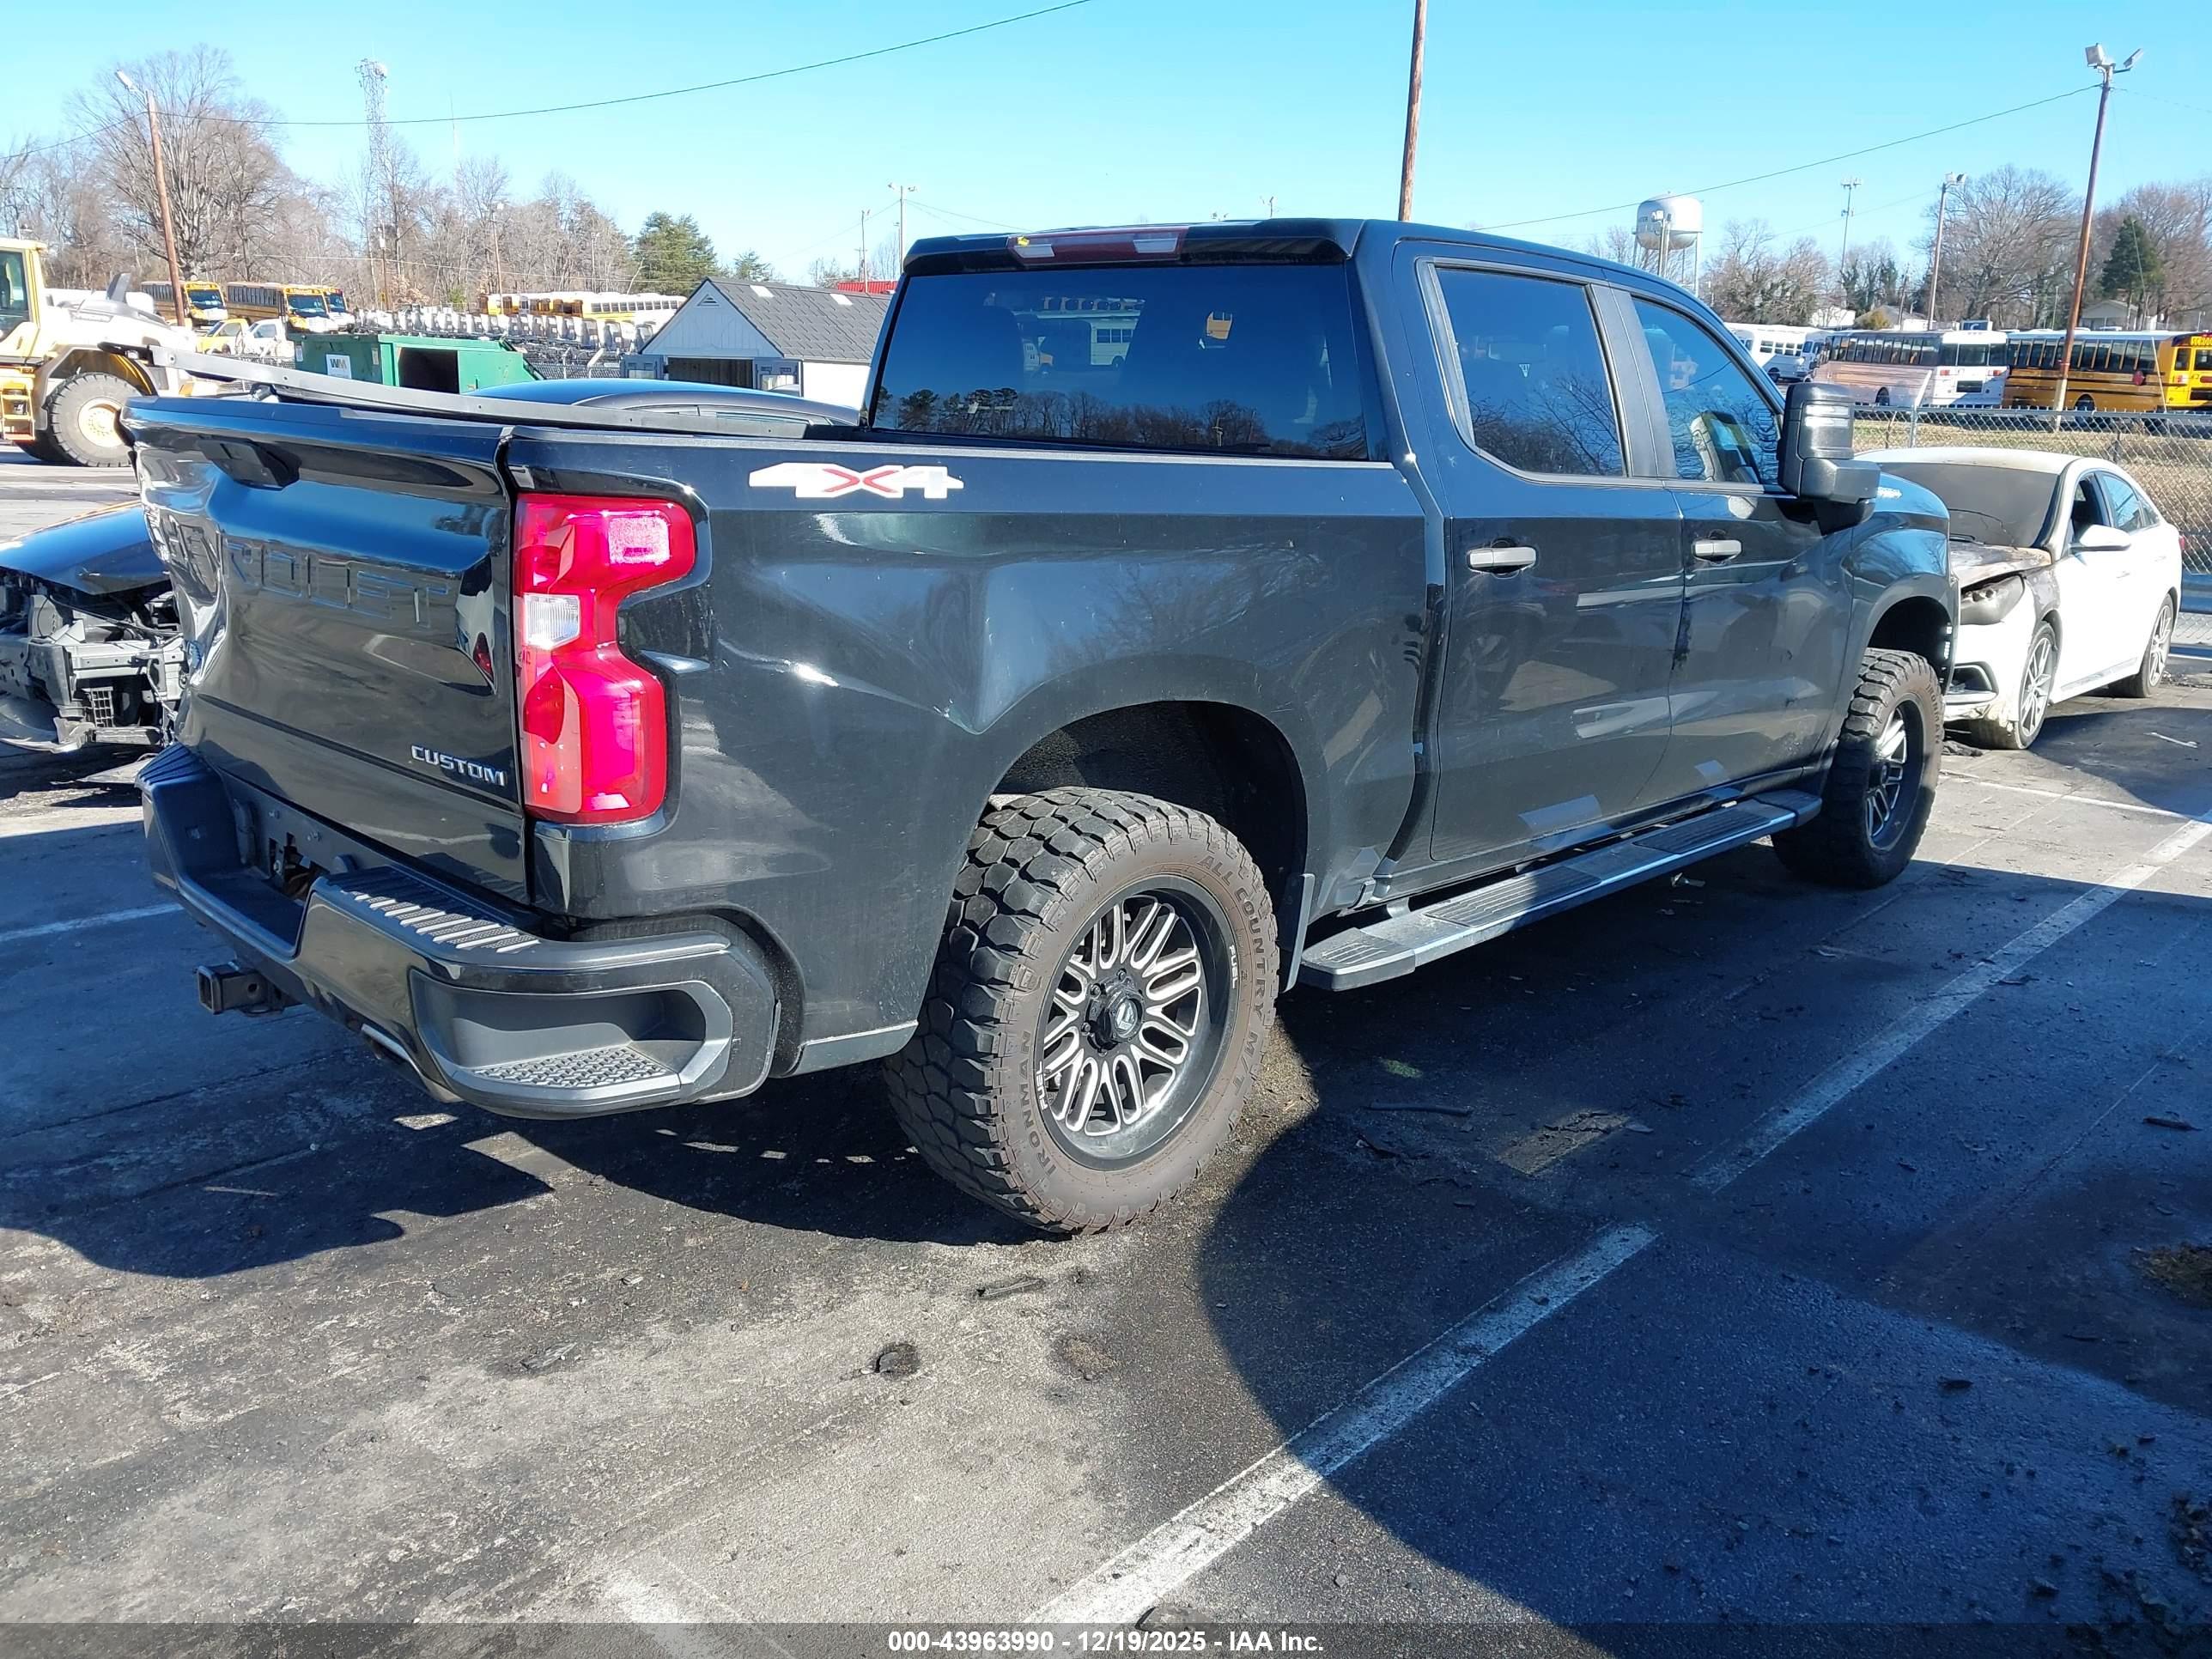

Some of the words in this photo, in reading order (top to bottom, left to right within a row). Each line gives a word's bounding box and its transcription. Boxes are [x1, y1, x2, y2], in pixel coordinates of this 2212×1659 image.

[330, 358, 347, 369] WM
[411, 744, 505, 787] CUSTOM
[1198, 855, 1233, 886] ALL
[1229, 945, 1239, 989] FUEL
[1236, 887, 1267, 1019] COUNTRY
[1036, 1061, 1048, 1111] FUEL
[1232, 1031, 1259, 1095] M/T
[1019, 1030, 1057, 1176] IRONMAN
